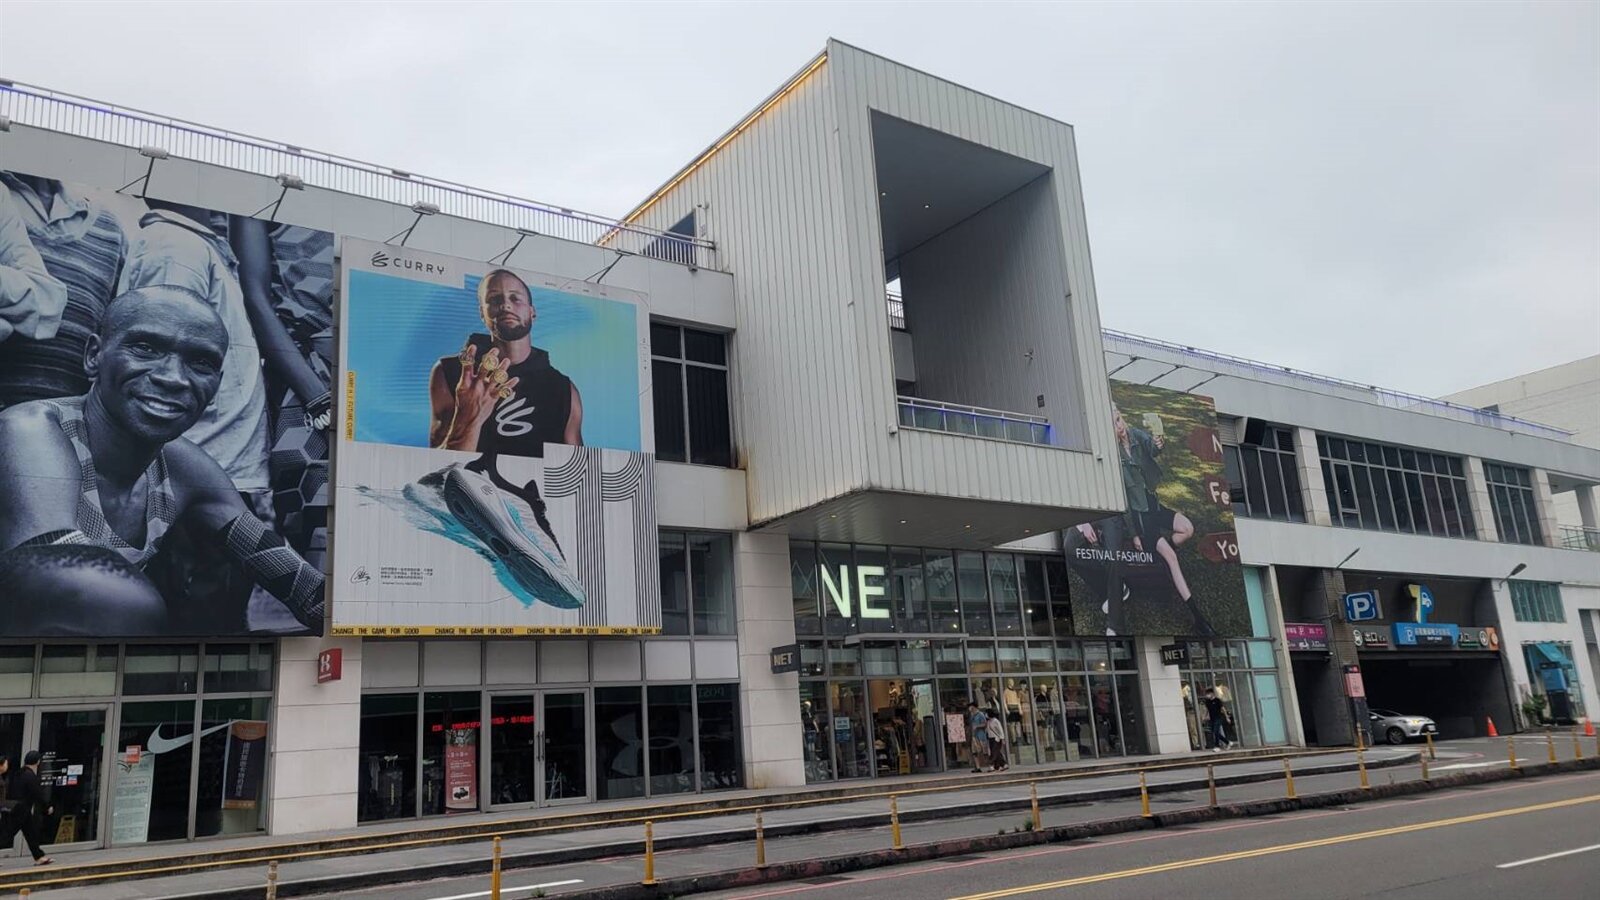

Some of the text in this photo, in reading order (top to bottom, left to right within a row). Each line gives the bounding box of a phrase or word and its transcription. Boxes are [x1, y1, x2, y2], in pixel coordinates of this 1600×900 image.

[393, 257, 445, 275] CURRY
[1076, 548, 1153, 563] FESTIVAL FASHION
[1216, 539, 1238, 559] Yo
[1352, 597, 1370, 620] P
[332, 627, 354, 635] CHANGE
[358, 627, 368, 635] THE
[372, 627, 387, 635] GAME
[390, 627, 400, 635] FOR
[773, 652, 793, 666] NET
[1164, 648, 1185, 661] NET
